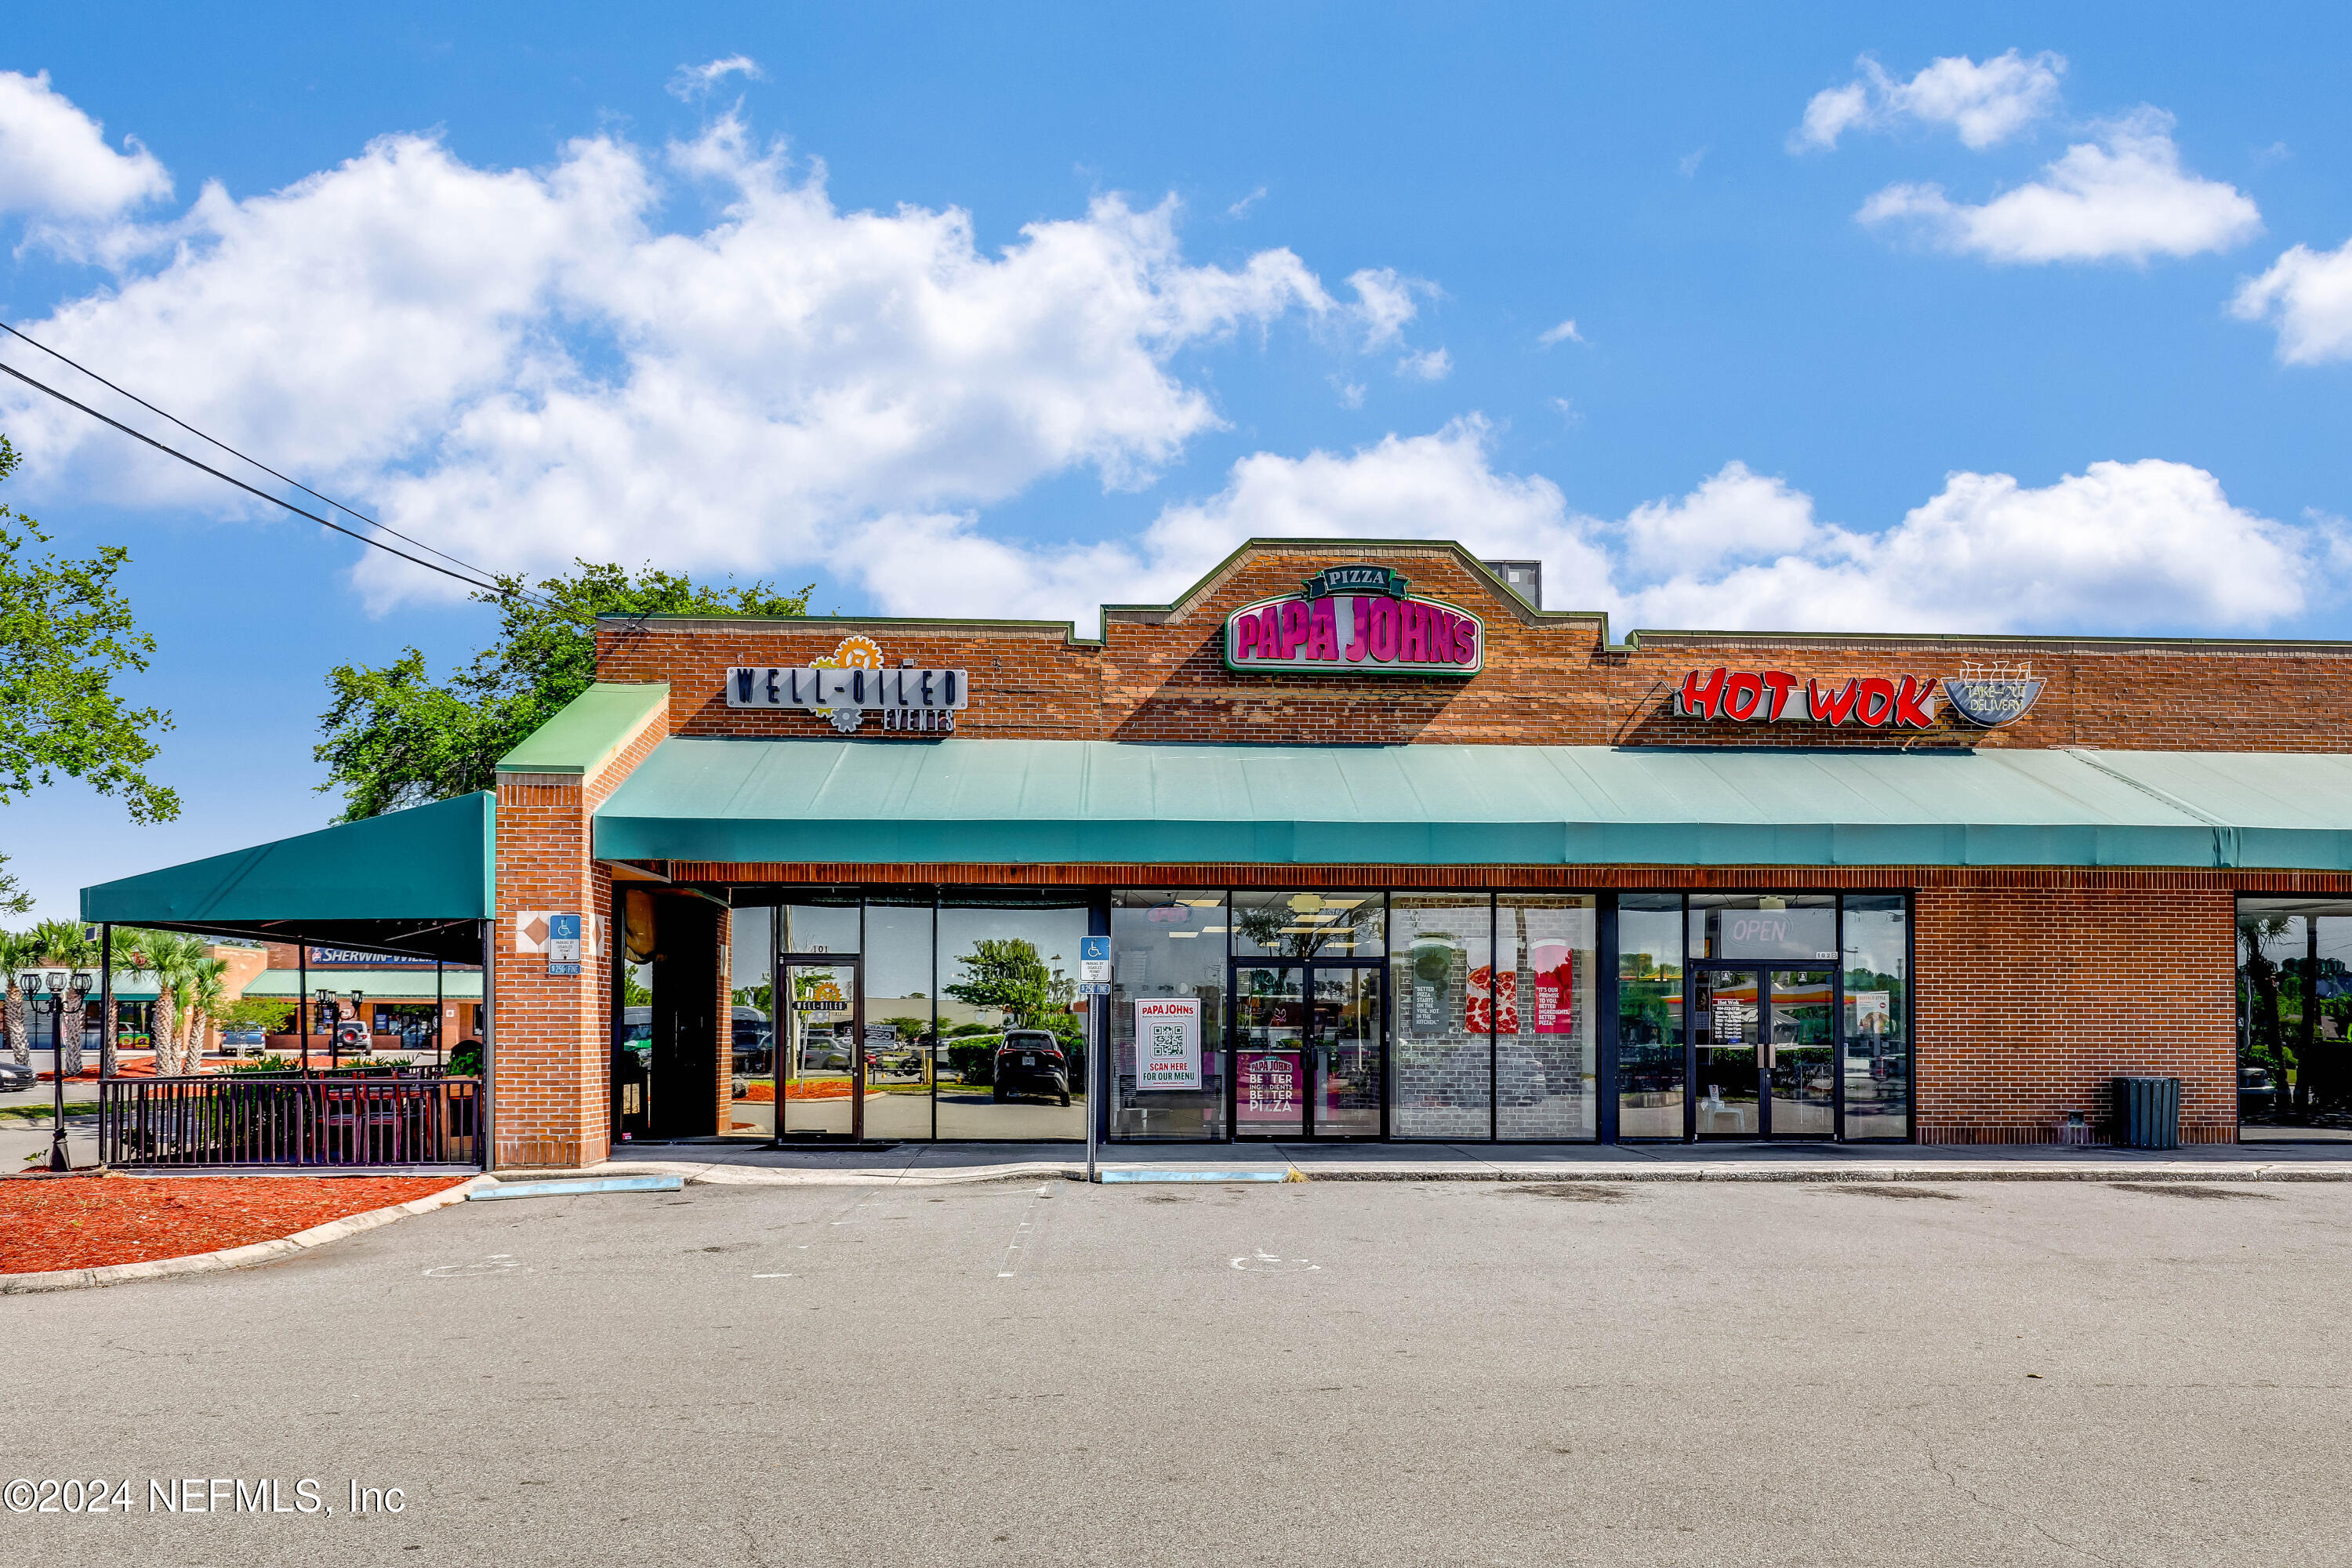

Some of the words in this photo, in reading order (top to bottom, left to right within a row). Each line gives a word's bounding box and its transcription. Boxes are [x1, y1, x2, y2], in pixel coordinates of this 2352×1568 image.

[1328, 570, 1385, 585] PIZZA
[1237, 597, 1339, 661] PAPA
[736, 668, 956, 706] WELL-OILED
[1965, 685, 2027, 698] TAKE-OUT
[1682, 666, 1798, 724] HOT
[1806, 673, 1939, 730] WOK
[1969, 699, 2024, 711] DELIVERY
[884, 709, 954, 731] EVENTS
[1733, 920, 1787, 942] OPEN
[1097, 985, 1108, 993] FINE
[1142, 1004, 1164, 1014] PAPA
[1164, 1004, 1194, 1014] JOHNS
[1252, 1061, 1269, 1071] PAPA
[1270, 1061, 1291, 1071] JOHNS
[1250, 1091, 1293, 1100] BETTER
[1250, 1099, 1293, 1112] PIZZA
